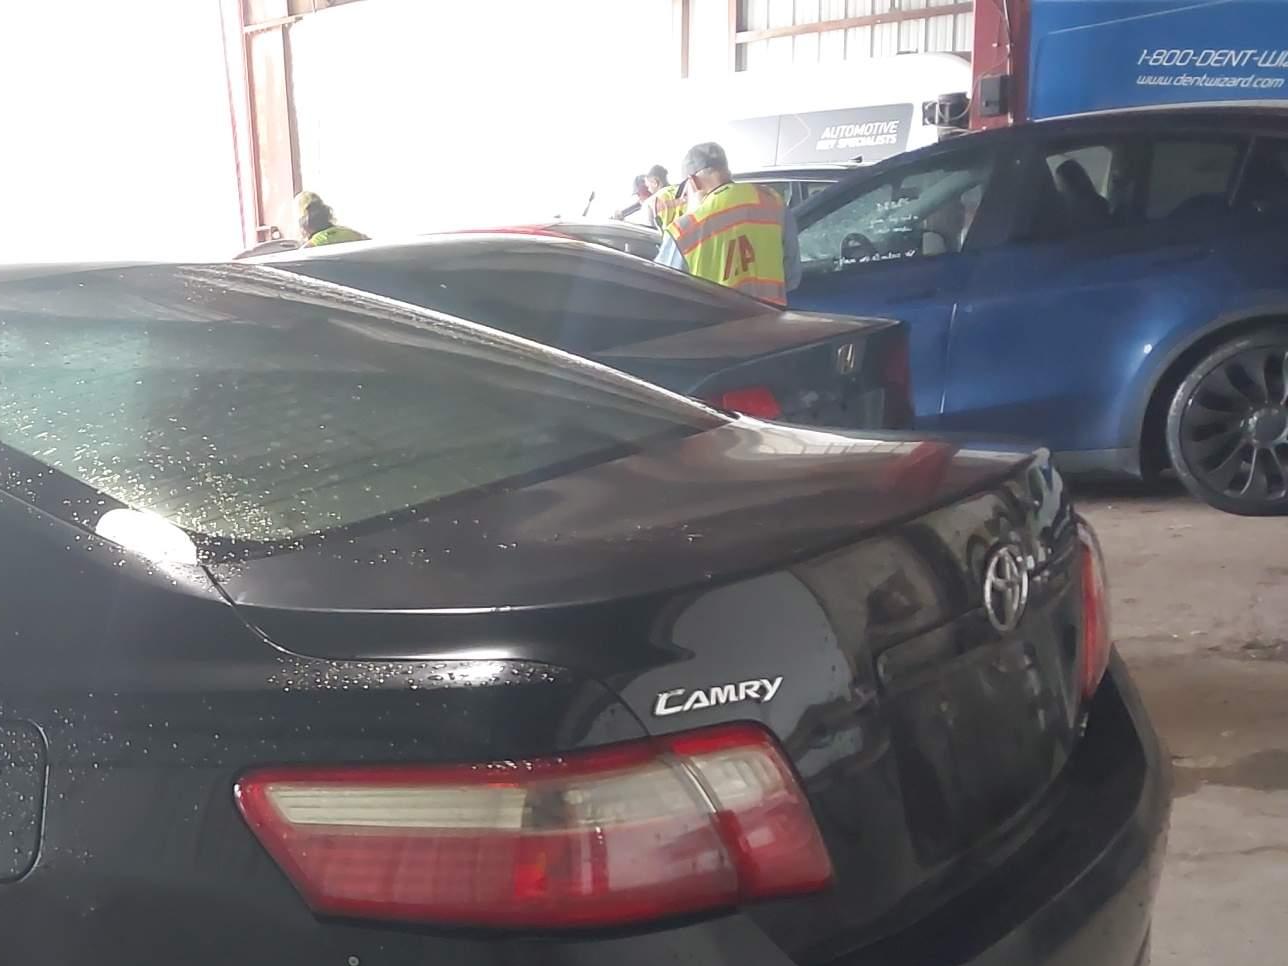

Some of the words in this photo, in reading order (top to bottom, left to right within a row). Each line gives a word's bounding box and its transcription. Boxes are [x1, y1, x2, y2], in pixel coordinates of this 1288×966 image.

[1136, 74, 1285, 88] www.dentwizard.com
[820, 120, 900, 139] AUTOMOTIVE
[655, 676, 784, 716] CAMRY
